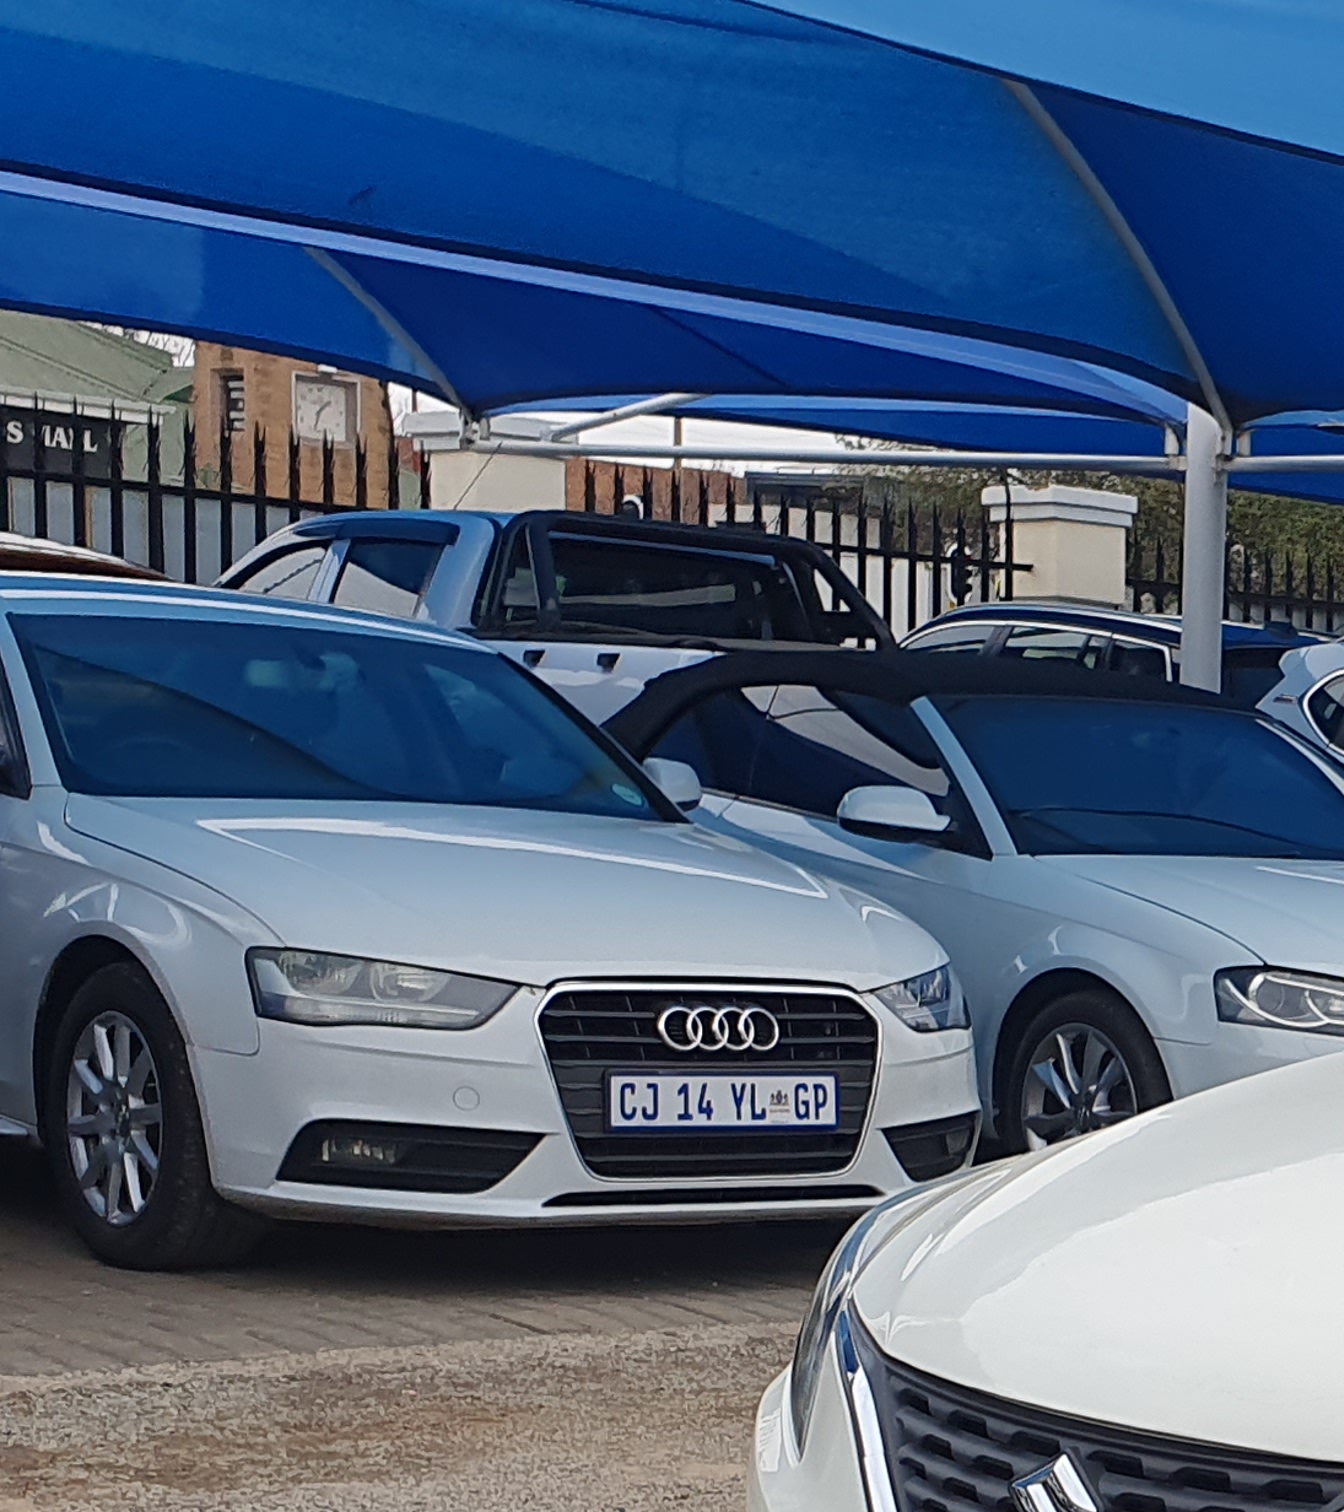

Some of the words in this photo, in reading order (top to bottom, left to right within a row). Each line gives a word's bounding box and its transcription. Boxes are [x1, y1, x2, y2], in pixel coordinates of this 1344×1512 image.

[619, 1083, 659, 1120] CJ
[677, 1082, 713, 1121] 14
[730, 1082, 767, 1121] YL
[794, 1082, 828, 1120] GP
